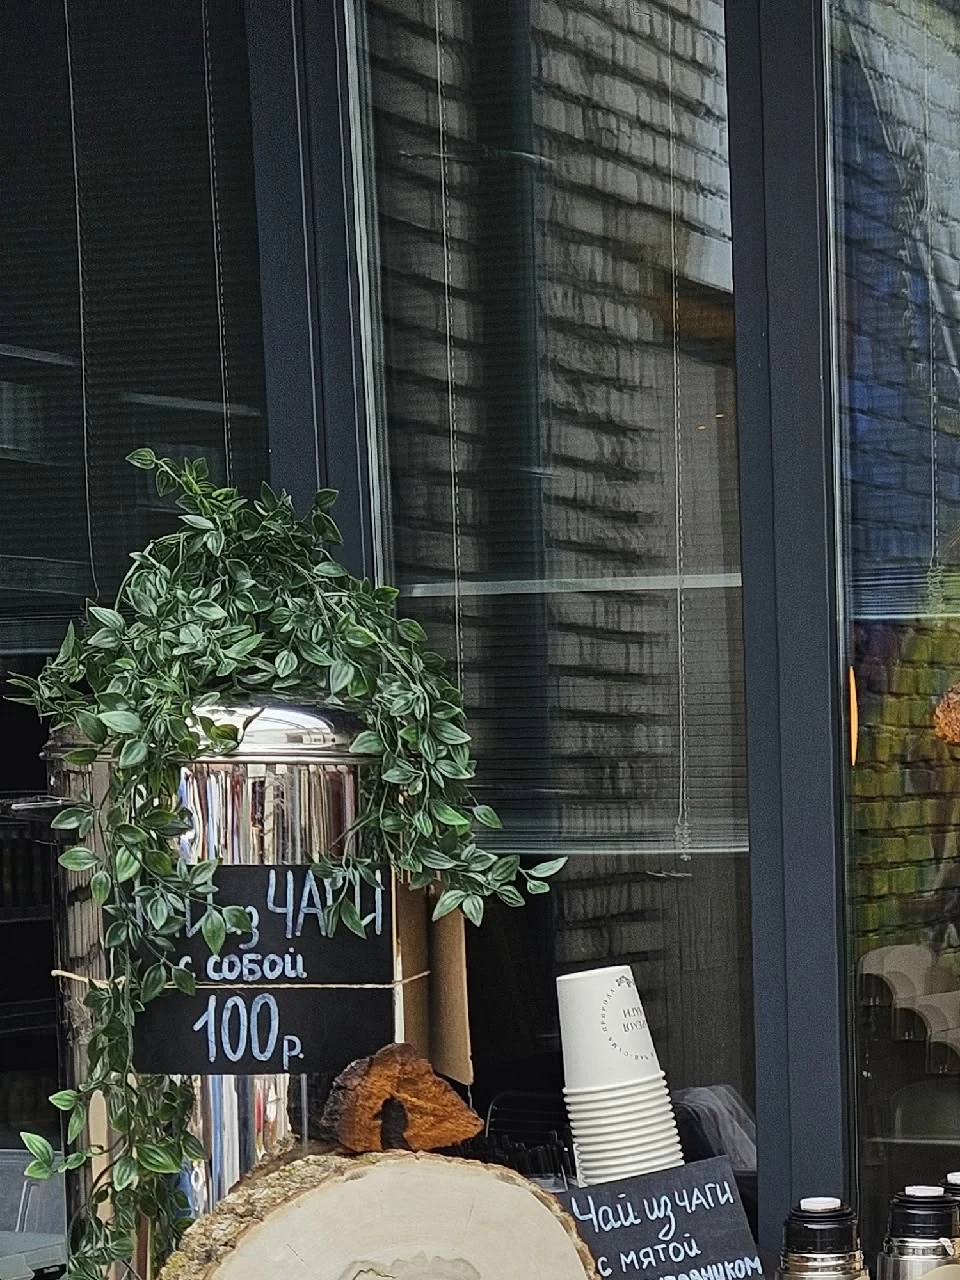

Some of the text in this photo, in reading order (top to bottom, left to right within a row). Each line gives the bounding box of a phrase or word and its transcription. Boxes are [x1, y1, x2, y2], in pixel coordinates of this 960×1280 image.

[206, 946, 307, 981] собой
[571, 1193, 641, 1233] Чай
[643, 1195, 676, 1241] из
